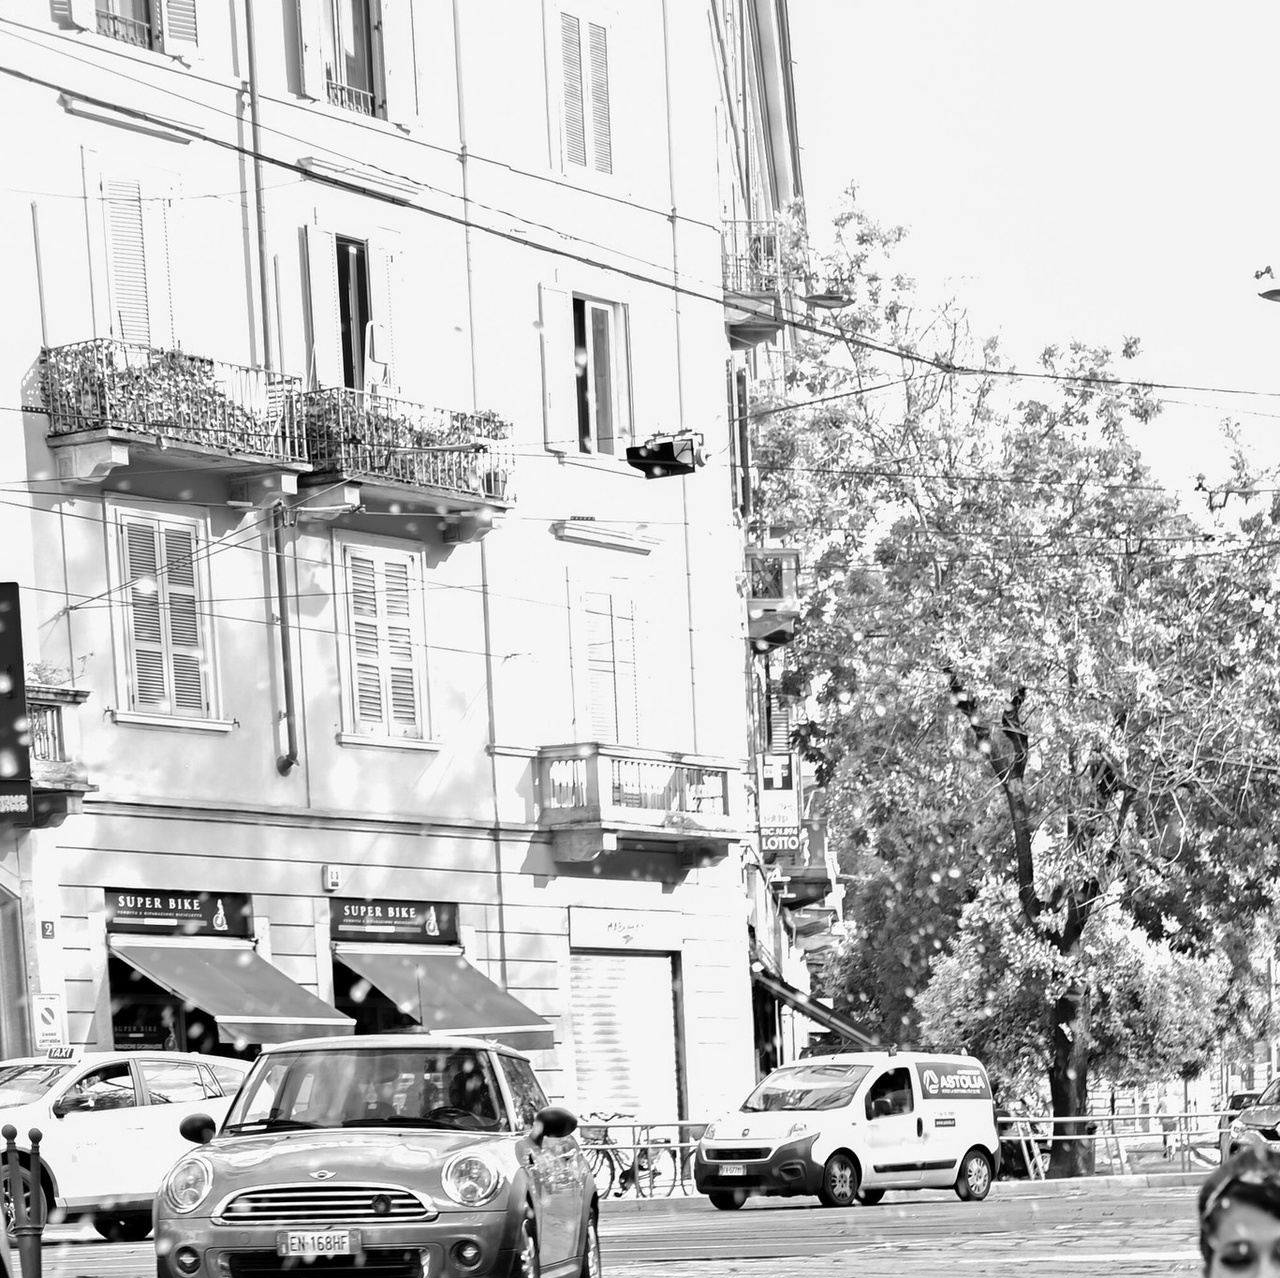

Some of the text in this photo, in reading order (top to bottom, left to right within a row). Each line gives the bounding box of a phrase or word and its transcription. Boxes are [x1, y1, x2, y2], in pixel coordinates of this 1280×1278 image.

[762, 836, 799, 850] LOTTO
[118, 895, 201, 910] SUPER BIKE
[343, 905, 417, 918] SUPER BIKE
[45, 922, 53, 935] 2
[50, 1048, 71, 1057] TAXI
